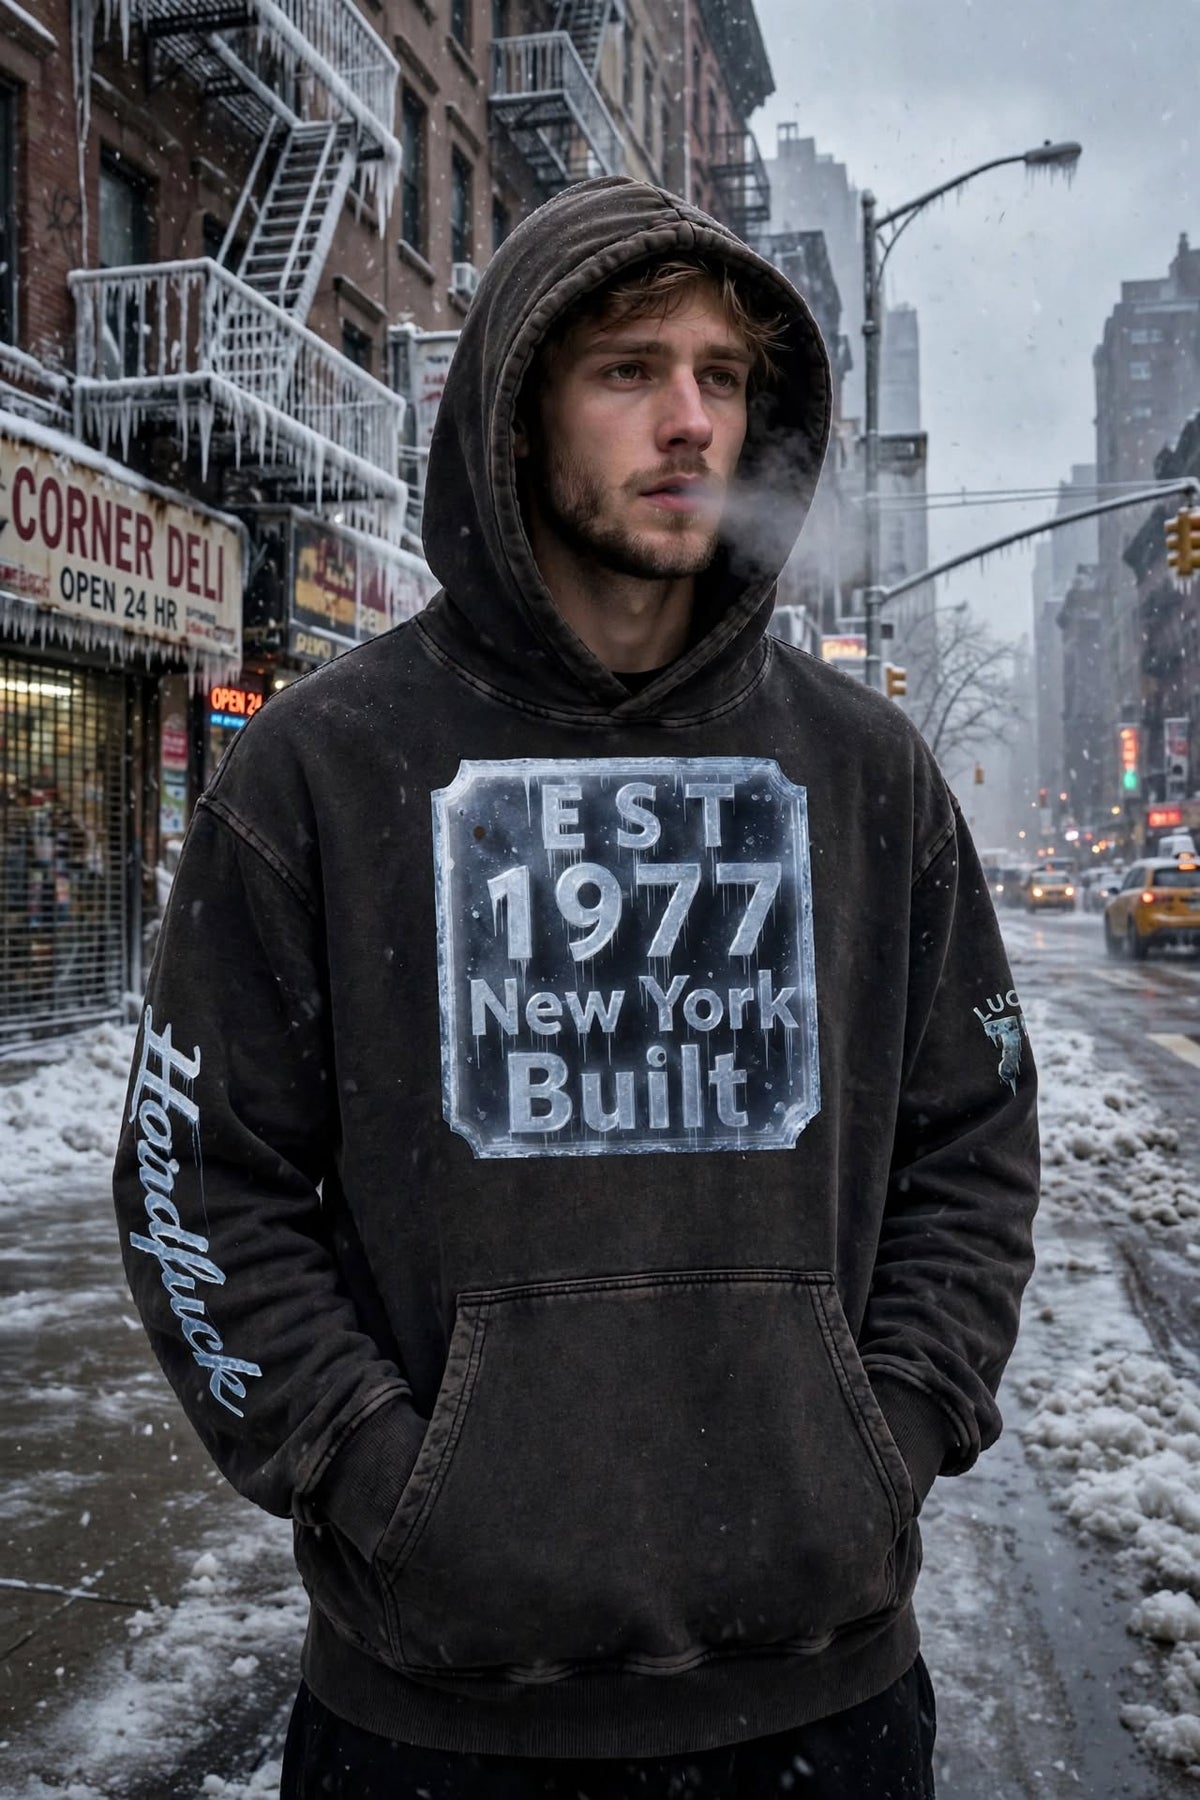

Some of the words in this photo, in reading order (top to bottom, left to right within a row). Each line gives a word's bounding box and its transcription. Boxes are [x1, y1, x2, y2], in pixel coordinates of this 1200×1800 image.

[12, 466, 154, 580] CORNER
[167, 524, 223, 603] DELI
[60, 566, 115, 613] OPEN
[124, 586, 147, 620] 24
[155, 594, 177, 631] HR
[211, 687, 245, 714] OPEN
[487, 862, 782, 962] 1977
[470, 978, 625, 1036] New
[638, 969, 799, 1032] York
[508, 1044, 749, 1133] Built
